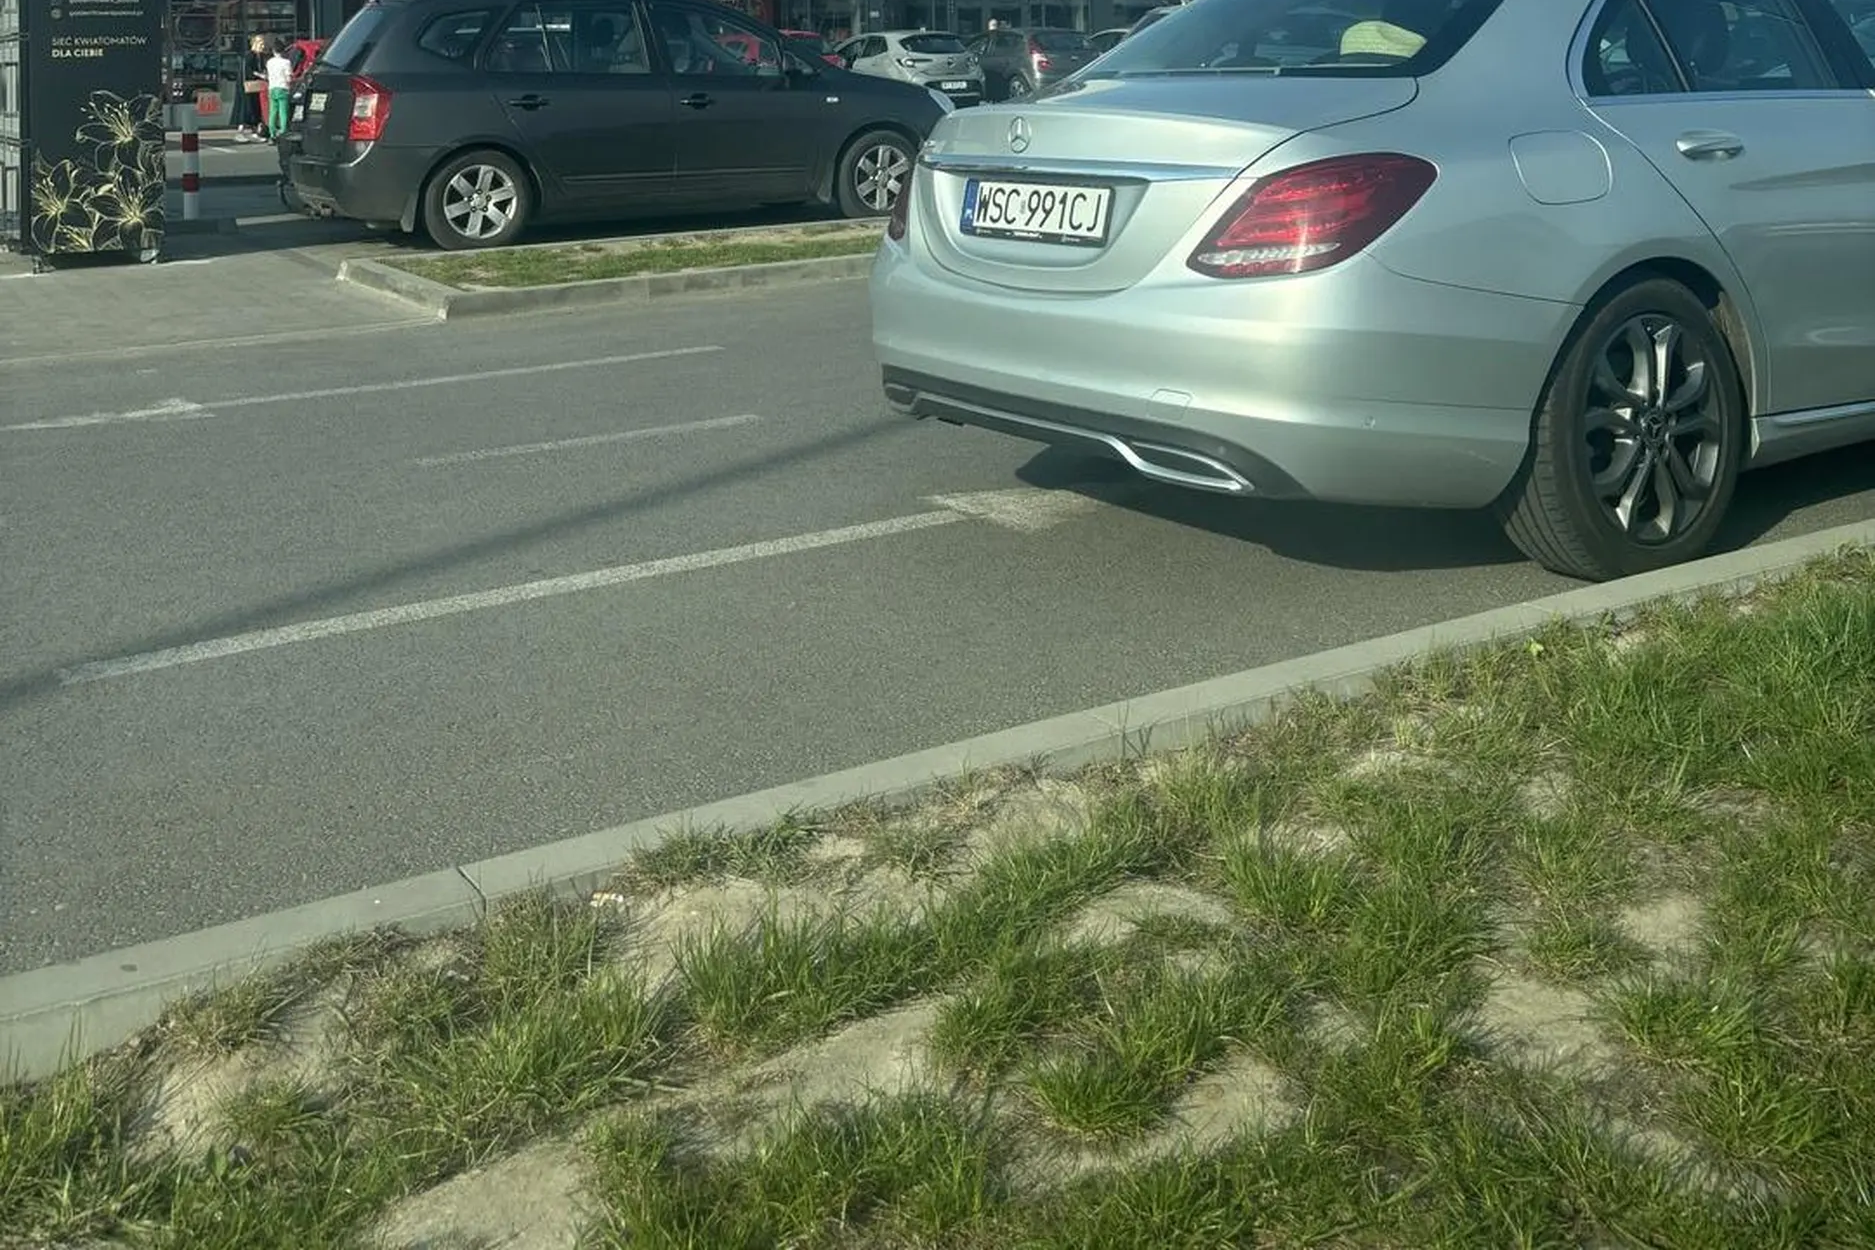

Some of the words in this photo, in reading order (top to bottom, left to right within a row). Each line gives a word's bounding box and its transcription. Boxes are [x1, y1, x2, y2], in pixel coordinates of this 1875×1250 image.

[51, 48, 72, 58] DLA
[73, 48, 104, 58] CIEBIE
[975, 186, 1021, 225] WSC
[1024, 190, 1102, 232] 991CJ
